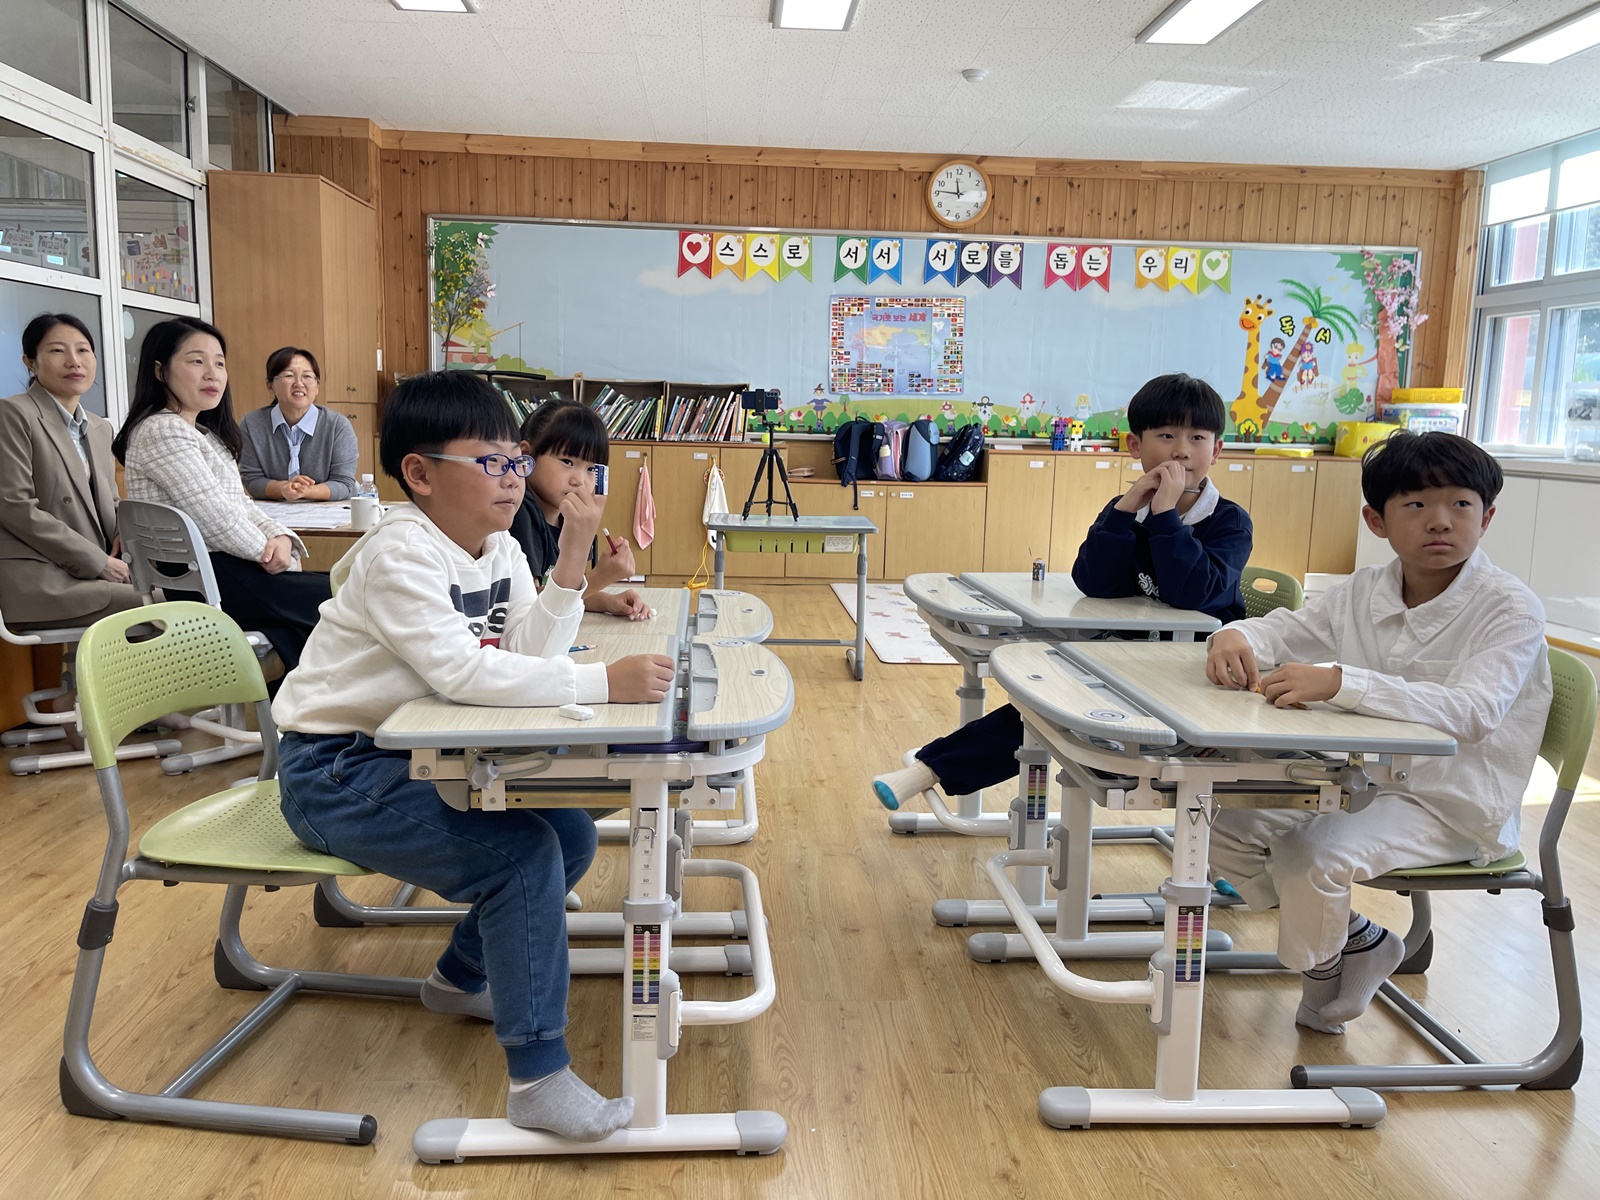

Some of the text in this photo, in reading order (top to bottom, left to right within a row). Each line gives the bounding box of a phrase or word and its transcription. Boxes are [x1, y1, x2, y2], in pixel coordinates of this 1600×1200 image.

[719, 241, 1188, 274] 스스로 서서 서로를 돕는 우리
[871, 312, 926, 322] 국기로 보는 세계
